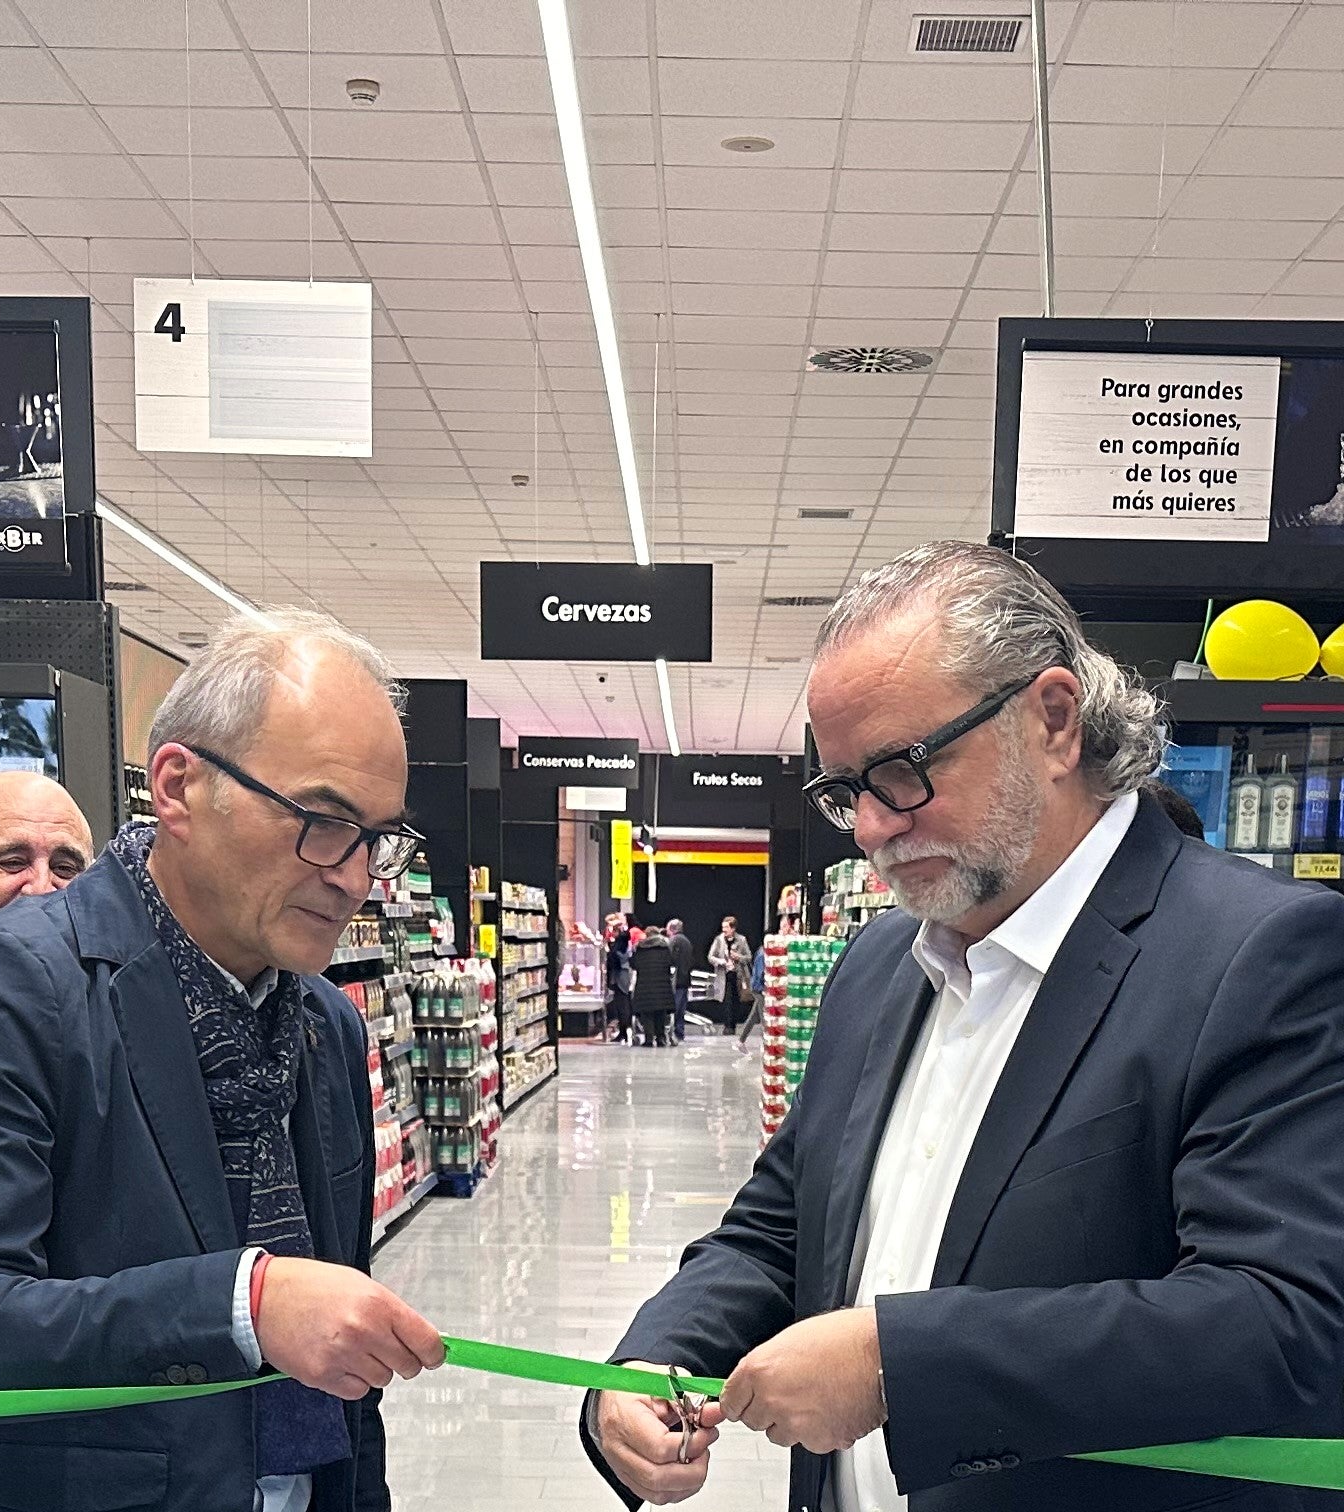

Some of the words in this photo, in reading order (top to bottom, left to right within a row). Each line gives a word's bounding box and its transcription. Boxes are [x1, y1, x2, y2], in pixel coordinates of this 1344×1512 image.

[154, 303, 186, 344] 4
[1101, 378, 1150, 397] Para
[1158, 381, 1243, 403] grandes
[1132, 408, 1241, 431] ocasiones,
[1099, 438, 1124, 453] en
[1132, 436, 1240, 460] compañía
[1126, 463, 1152, 482] de
[1160, 464, 1191, 483] los
[1199, 469, 1238, 488] que
[1112, 490, 1154, 510] más
[1162, 492, 1236, 515] quieres
[541, 595, 653, 625] Cervezas
[523, 753, 584, 768] Conservas
[587, 754, 636, 770] Pescado
[693, 772, 728, 786] Frutos
[730, 773, 763, 786] Secos
